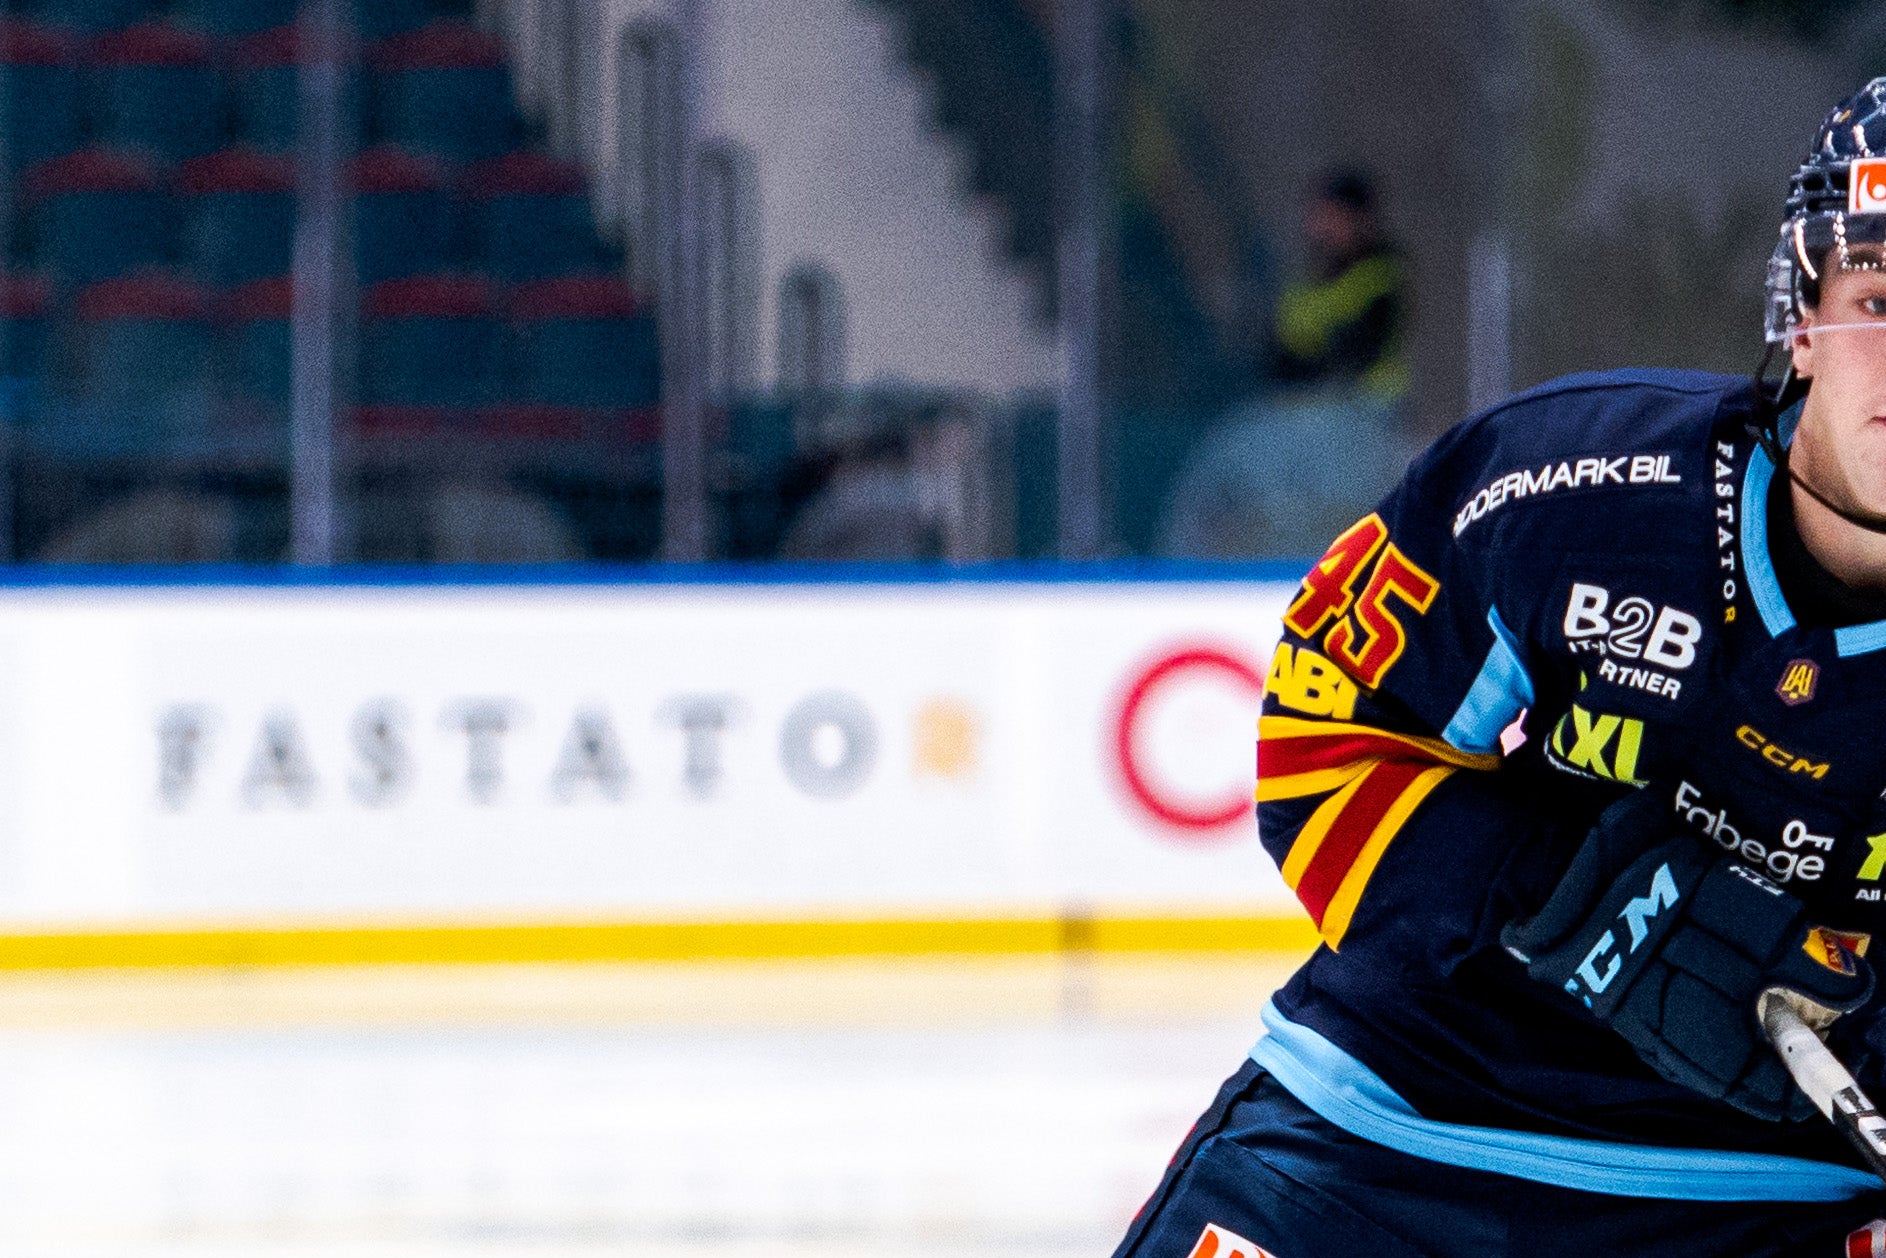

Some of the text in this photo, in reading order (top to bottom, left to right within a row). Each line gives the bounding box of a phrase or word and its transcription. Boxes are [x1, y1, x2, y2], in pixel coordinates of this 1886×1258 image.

[1629, 454, 1681, 483] BIL
[1715, 440, 1737, 625] FASTATOR
[1281, 511, 1441, 690] 45
[1563, 582, 1702, 670] B2B
[1552, 703, 1650, 789] XL
[1735, 724, 1832, 780] CCM
[1675, 780, 1825, 883] Fabege
[1855, 888, 1881, 901] All
